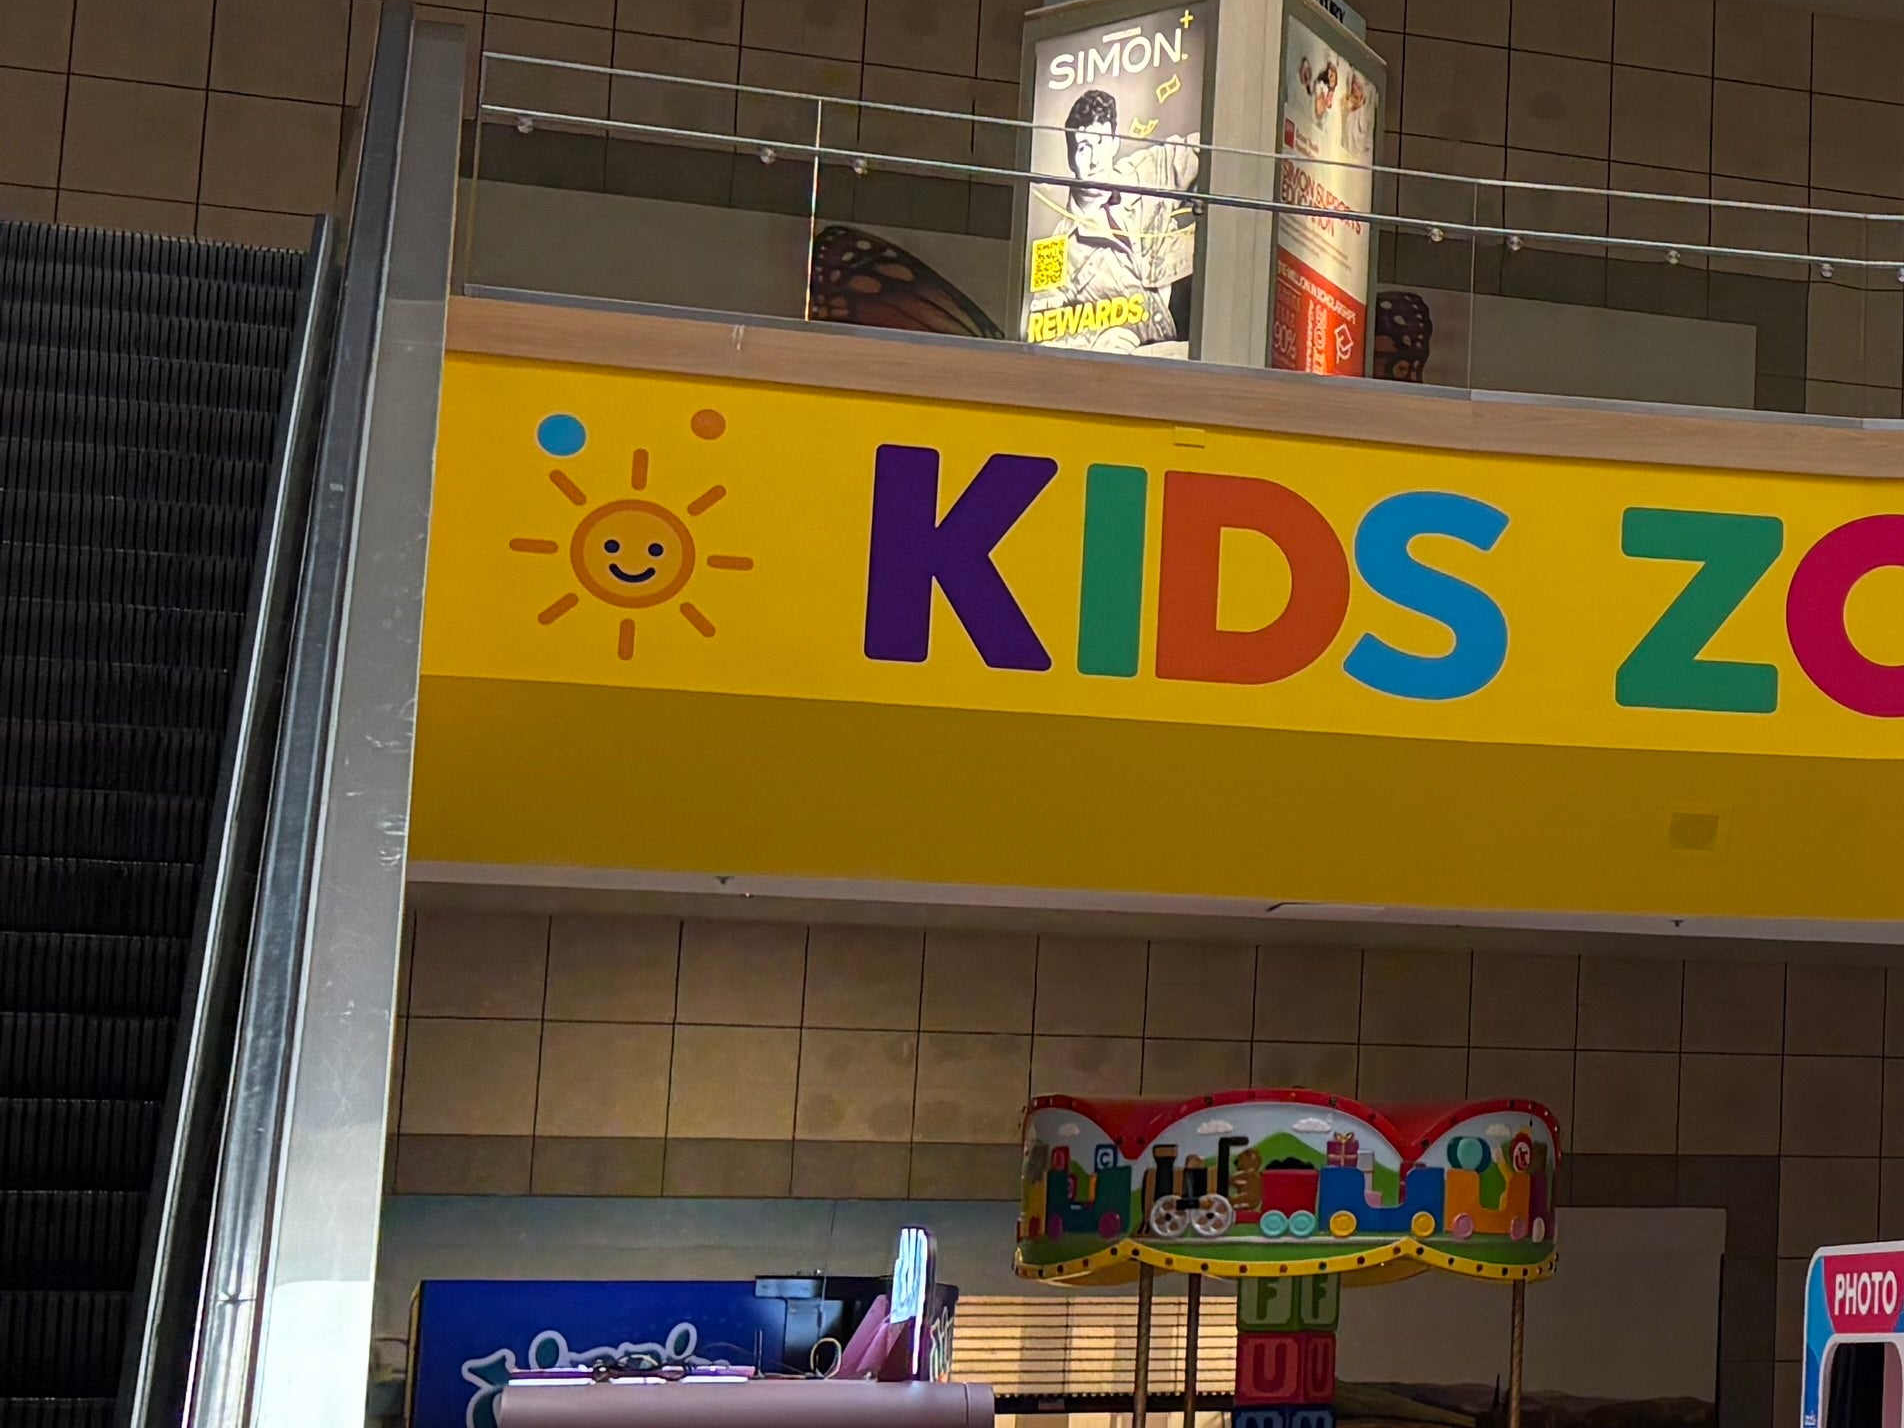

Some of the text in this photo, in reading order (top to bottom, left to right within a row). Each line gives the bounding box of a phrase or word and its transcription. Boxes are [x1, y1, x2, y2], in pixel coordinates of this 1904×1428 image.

[1028, 293, 1149, 343] REWARDS.
[863, 443, 1511, 700] KIDS
[1834, 1270, 1897, 1316] PHOTO
